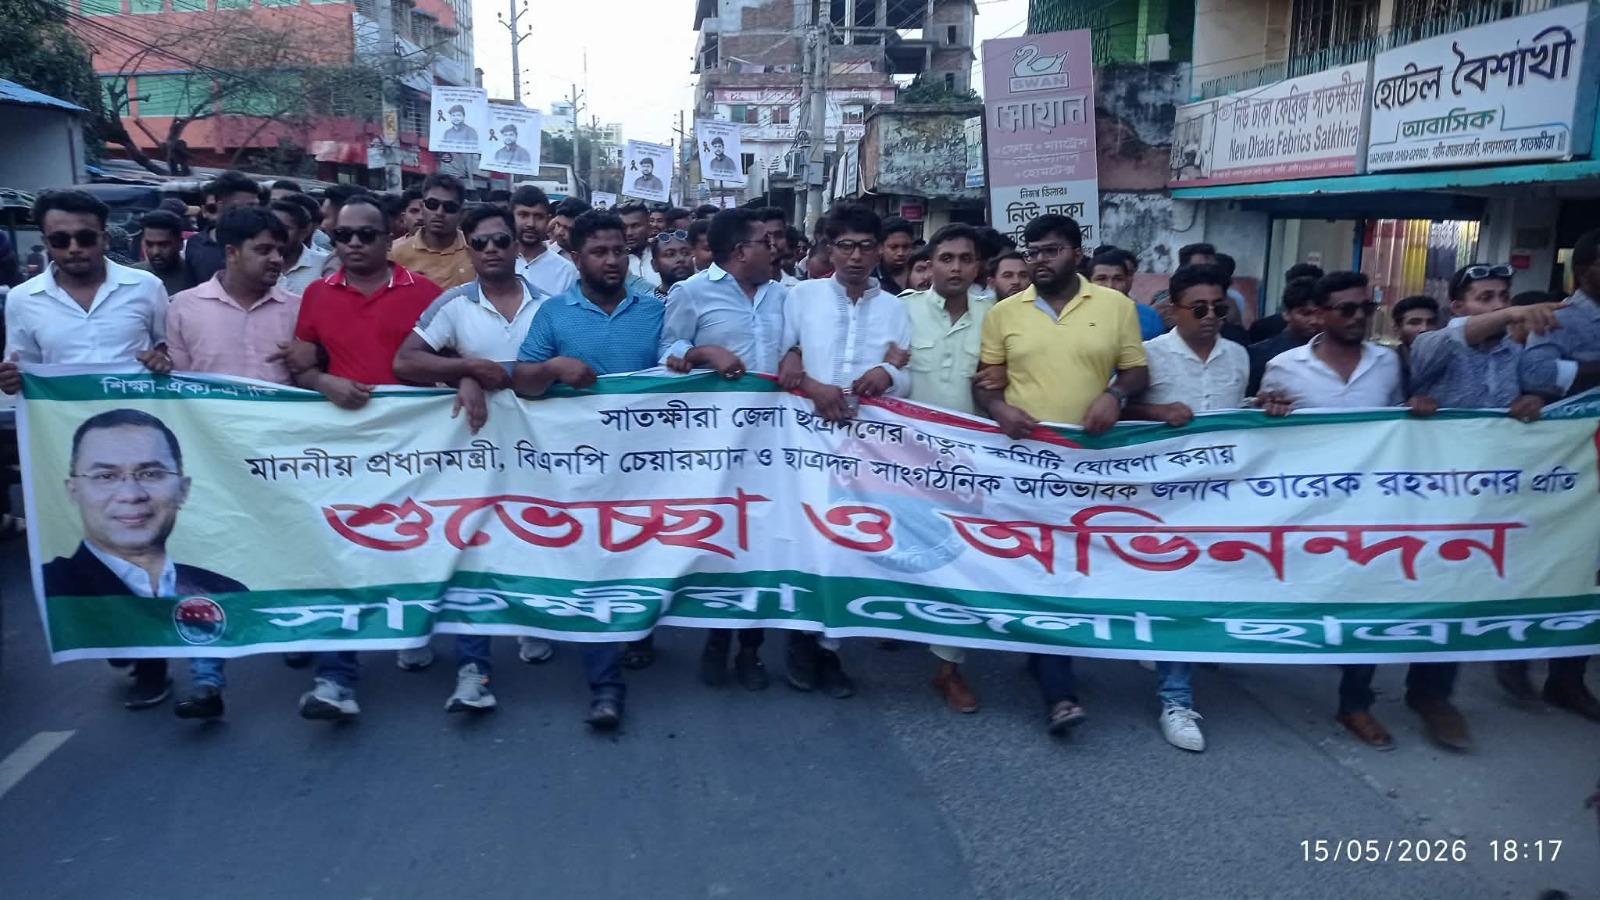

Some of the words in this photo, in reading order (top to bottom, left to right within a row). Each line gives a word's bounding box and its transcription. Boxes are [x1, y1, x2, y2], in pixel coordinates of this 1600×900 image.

[1012, 76, 1066, 91] SWAN
[1374, 62, 1443, 109] হোটেল
[1452, 25, 1576, 95] বৈশাখী
[996, 95, 1088, 133] সোয়ান
[1312, 74, 1364, 119] সাতক্ষীরা
[1228, 137, 1247, 161] New
[1247, 131, 1274, 158] Dhaka
[1276, 128, 1311, 155] Febrics
[1313, 119, 1360, 152] Satkhira
[1402, 106, 1497, 138] আবাসিক
[1006, 201, 1041, 224] নিউ
[599, 402, 722, 432] সাতক্ষীরা
[731, 405, 787, 428] জেলা
[795, 407, 906, 445] ছাত্রদলের
[1073, 454, 1158, 477] ঘোষণা
[247, 447, 357, 481] মাননীয়
[366, 439, 506, 477] প্রধানমন্ত্রী,
[515, 440, 610, 474] বিএনপি
[620, 448, 748, 474] চেয়ারম্যান
[756, 449, 774, 467] ও
[782, 447, 862, 478] ছাত্রদল
[870, 461, 1005, 497] সাংগঠনিক
[1014, 472, 1144, 502] অভিভাবক
[1150, 477, 1234, 502] জনাব
[1244, 471, 1363, 499] তারেক
[1372, 468, 1524, 500] রহমানের
[1530, 465, 1580, 494] প্রতি
[322, 487, 770, 560] শুভেচ্ছা
[802, 503, 895, 553] ও
[938, 505, 1526, 581] অভিনন্দন
[251, 582, 812, 632] সাতক্ষীরা
[847, 595, 1177, 644] জেলা
